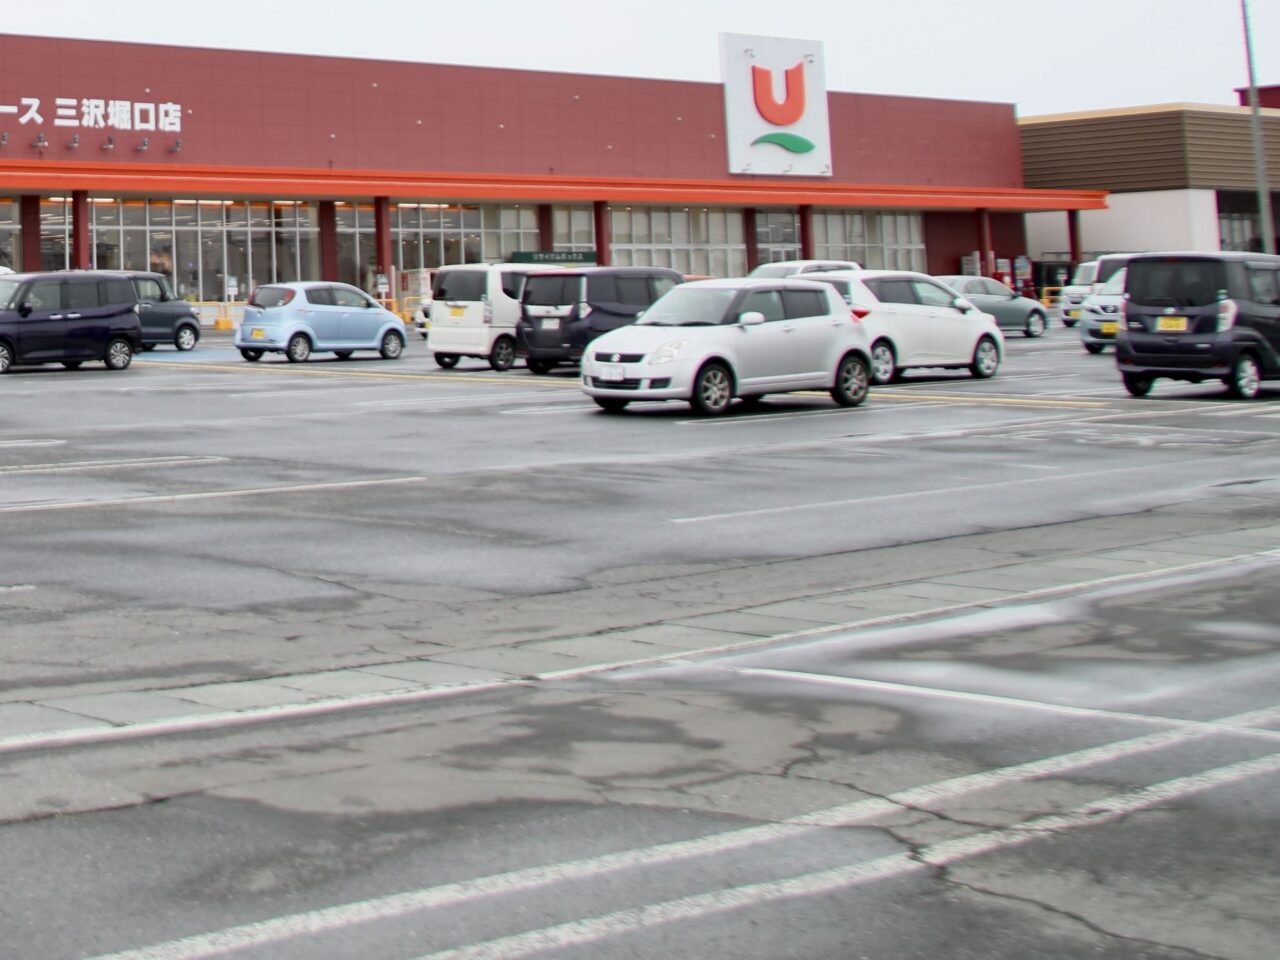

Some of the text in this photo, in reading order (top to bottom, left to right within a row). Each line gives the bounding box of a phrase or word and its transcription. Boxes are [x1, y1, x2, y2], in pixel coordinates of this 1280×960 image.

[53, 97, 183, 132] 三沢堀口店
[751, 61, 806, 127] U
